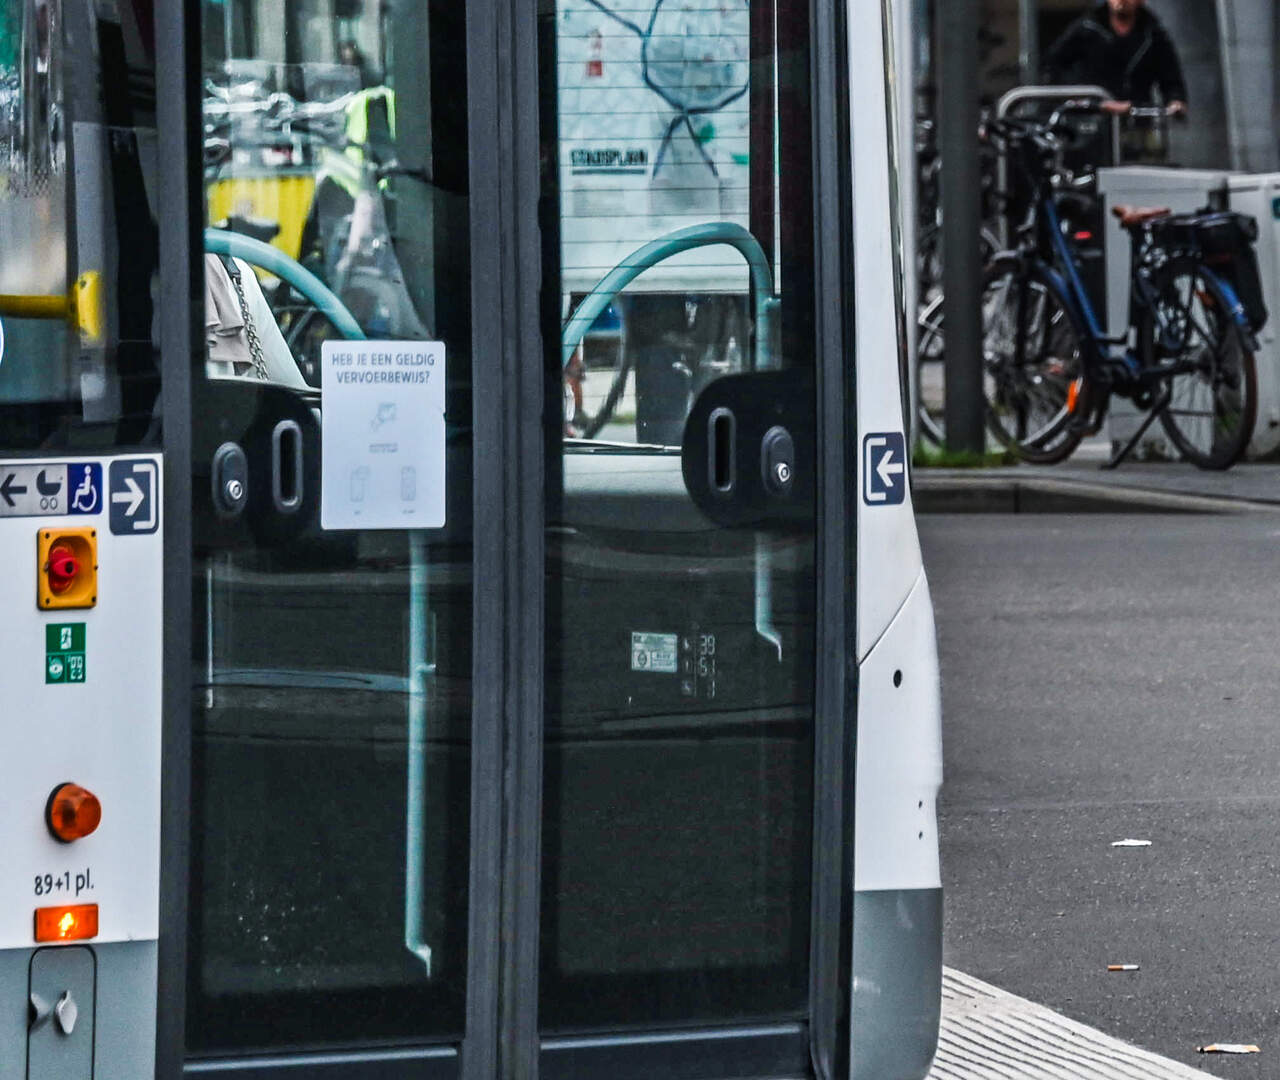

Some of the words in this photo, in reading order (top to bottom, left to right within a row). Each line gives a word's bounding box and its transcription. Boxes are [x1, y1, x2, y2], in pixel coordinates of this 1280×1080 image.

[332, 353, 353, 366] HEB
[357, 354, 366, 366] JE
[371, 354, 392, 366] EEN
[396, 353, 435, 366] GELDIG
[337, 371, 430, 384] VERVOERBEWIJS?
[34, 871, 70, 896] 89+1
[75, 868, 95, 897] pl.
